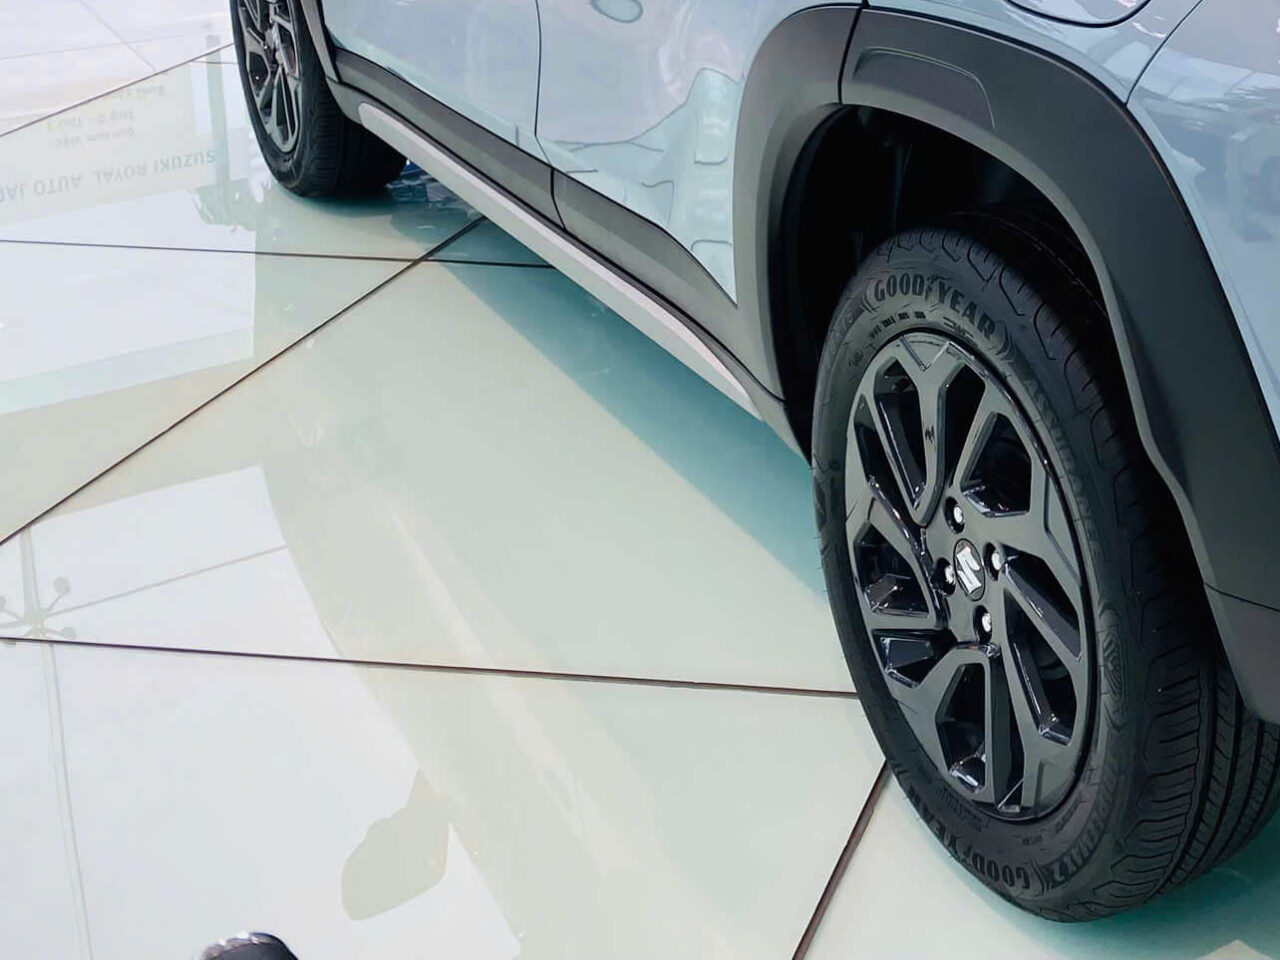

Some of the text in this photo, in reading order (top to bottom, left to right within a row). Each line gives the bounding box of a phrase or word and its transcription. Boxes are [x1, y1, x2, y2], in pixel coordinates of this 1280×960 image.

[153, 149, 216, 174] SUZUKI
[33, 173, 83, 196] AUTO
[92, 162, 147, 186] ROYAL
[873, 272, 997, 341] GOODYEAR
